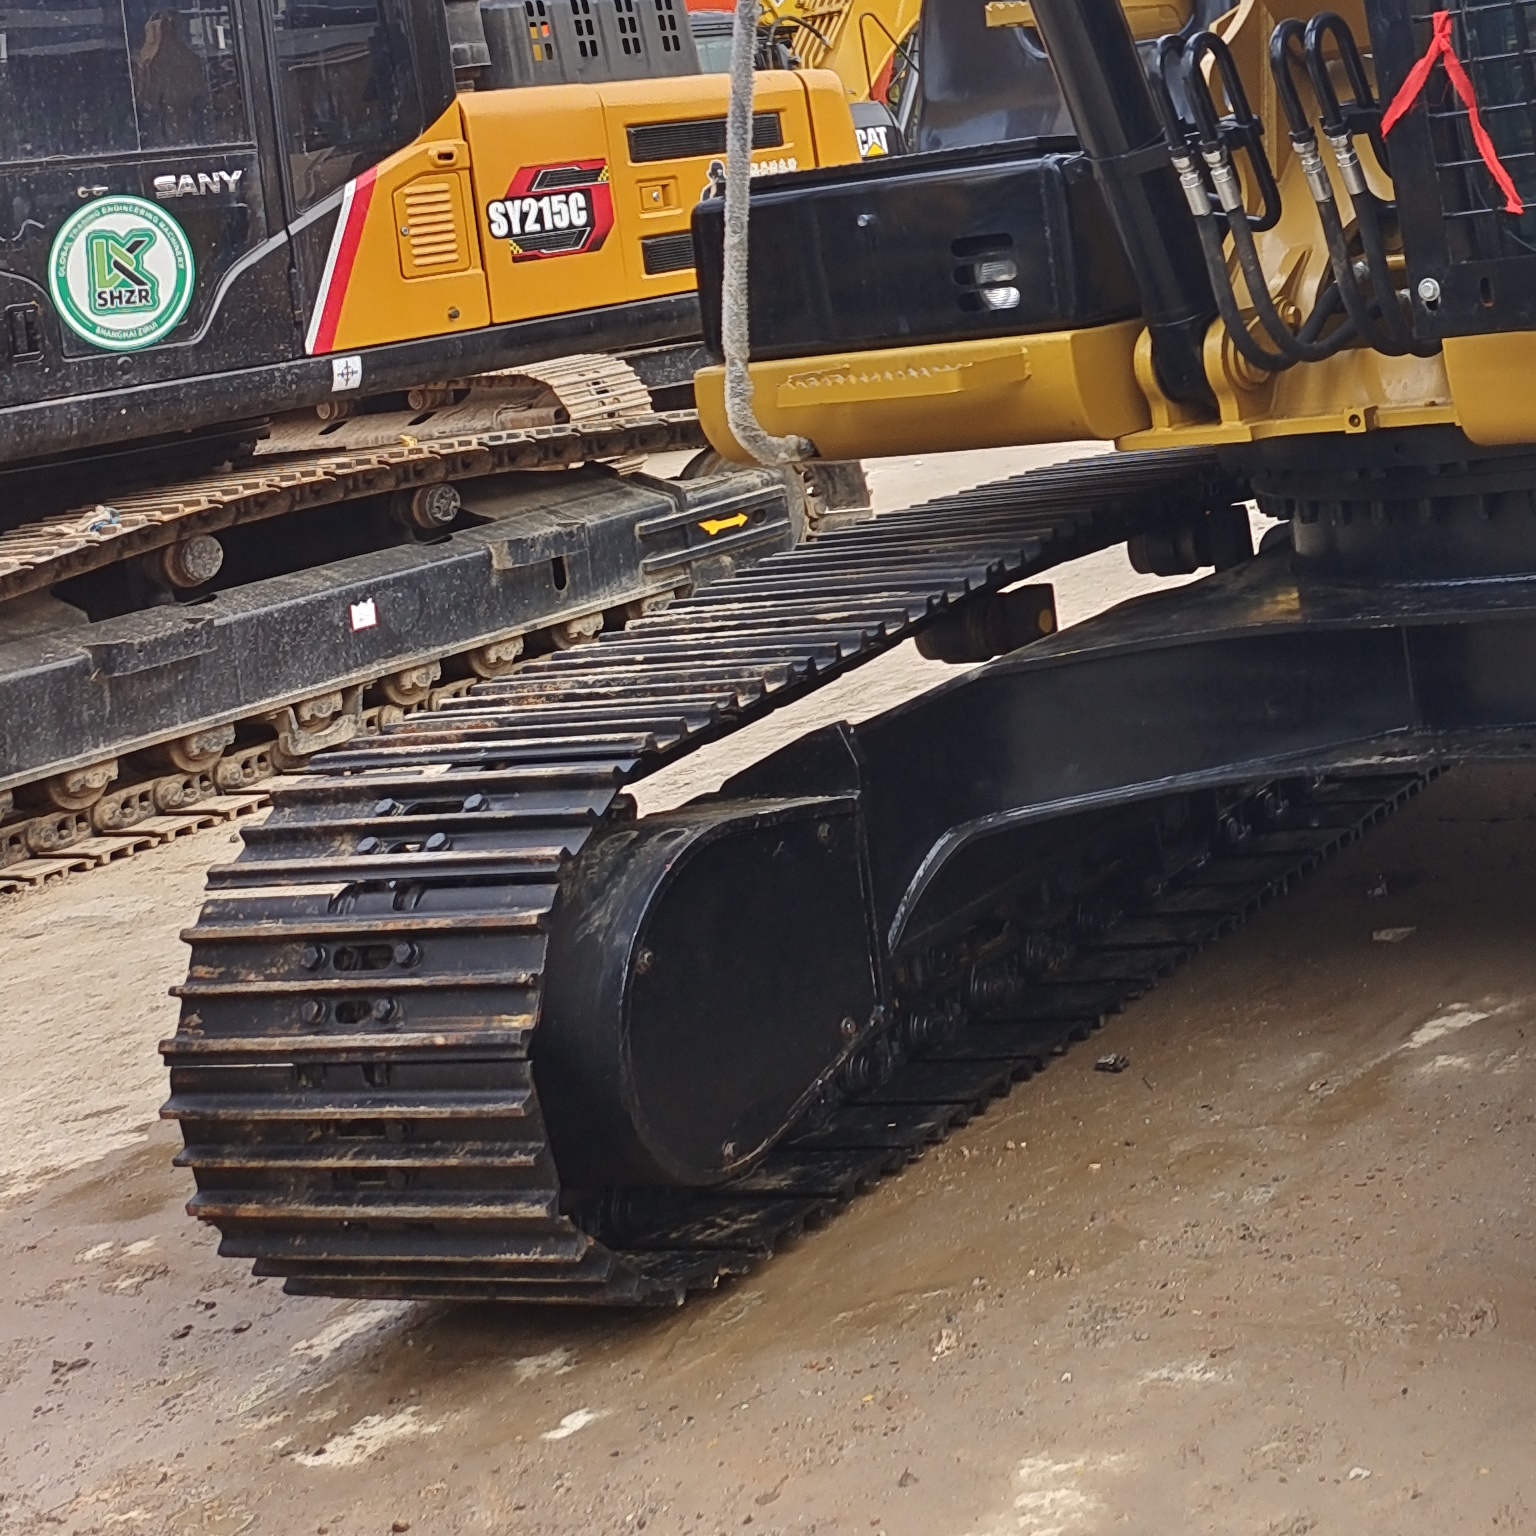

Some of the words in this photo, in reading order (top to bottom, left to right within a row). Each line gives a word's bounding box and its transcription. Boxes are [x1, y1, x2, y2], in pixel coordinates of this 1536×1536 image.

[855, 126, 889, 157] CAT
[153, 169, 243, 200] SANY
[487, 191, 589, 239] SY215C
[97, 286, 151, 308] SHZR
